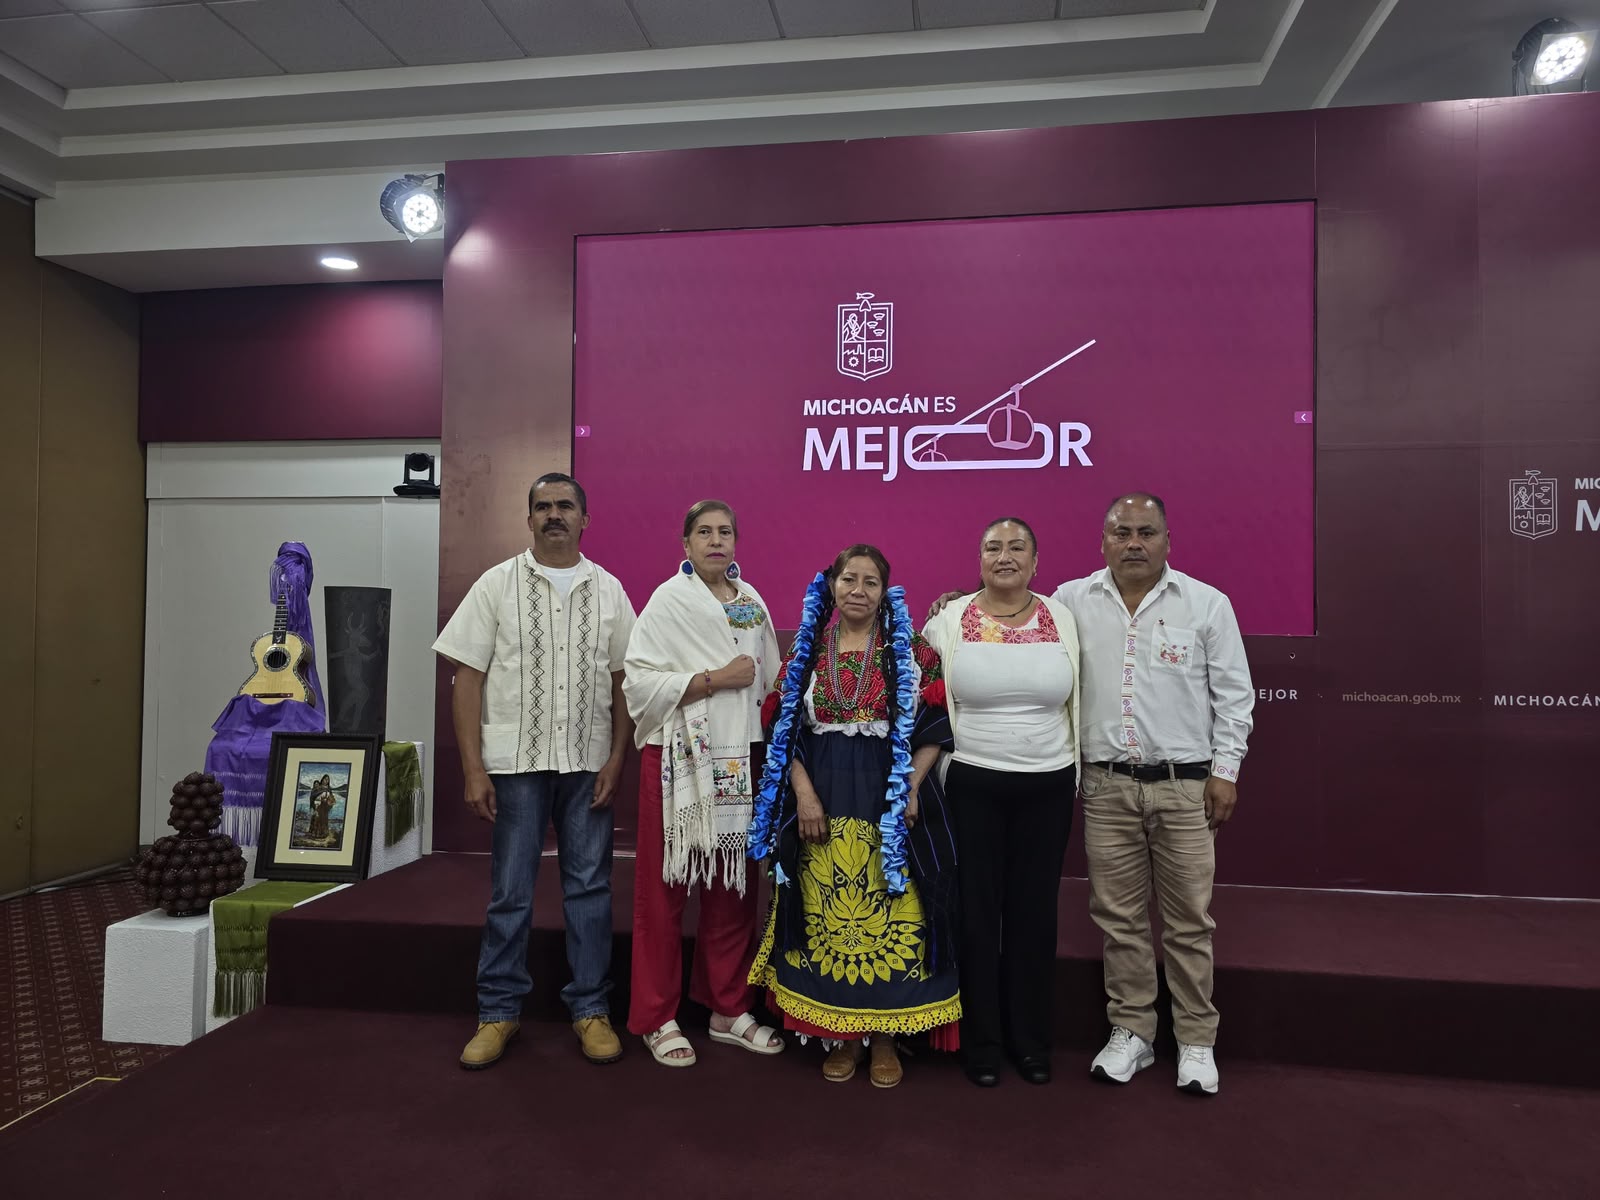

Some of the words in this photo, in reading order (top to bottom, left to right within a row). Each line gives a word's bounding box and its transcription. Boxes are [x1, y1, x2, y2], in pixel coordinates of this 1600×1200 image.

[803, 394, 929, 416] MICHOACÁN
[934, 396, 957, 413] ES
[802, 422, 1094, 482] MEJOR
[1253, 688, 1298, 702] EJOR
[1342, 691, 1461, 705] michoacan.gob.mx
